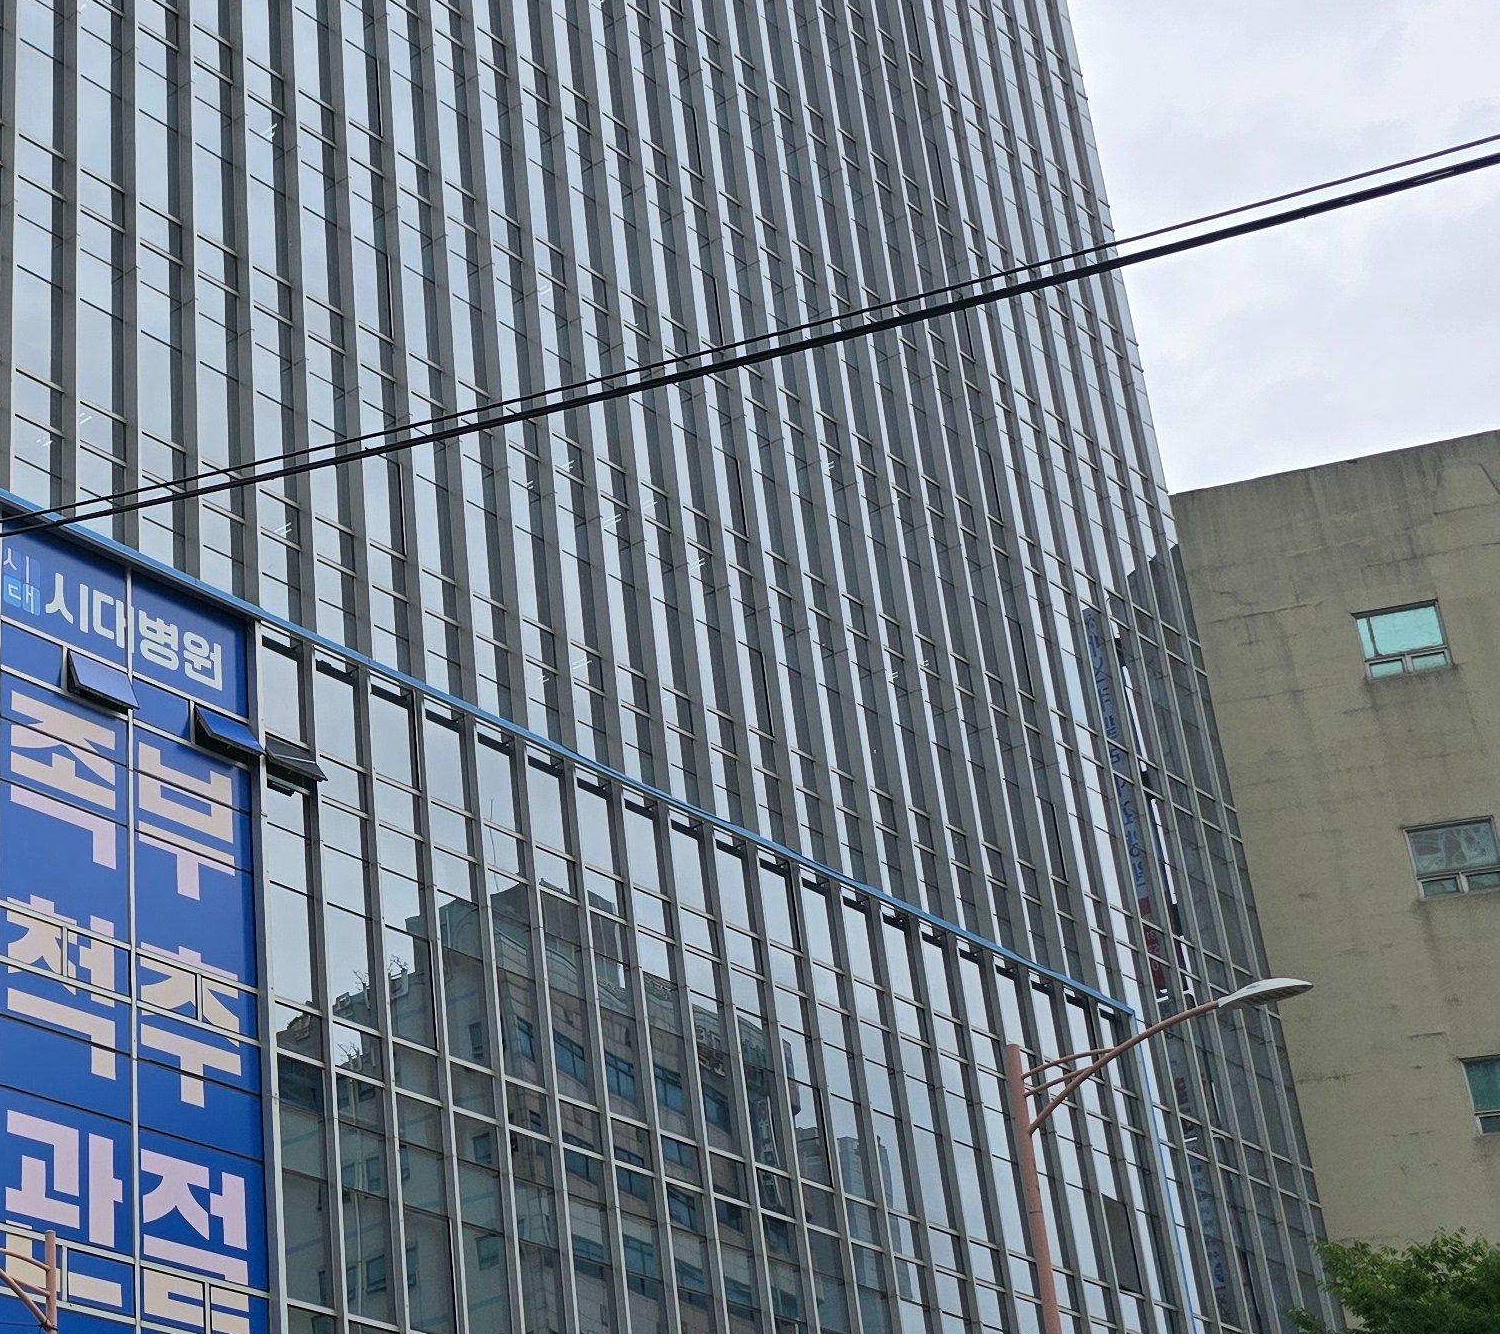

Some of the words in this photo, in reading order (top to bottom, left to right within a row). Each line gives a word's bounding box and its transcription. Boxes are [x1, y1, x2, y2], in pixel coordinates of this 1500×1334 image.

[44, 570, 223, 691] 시대병원
[10, 692, 235, 901] 족부
[5, 894, 241, 1107] 척추
